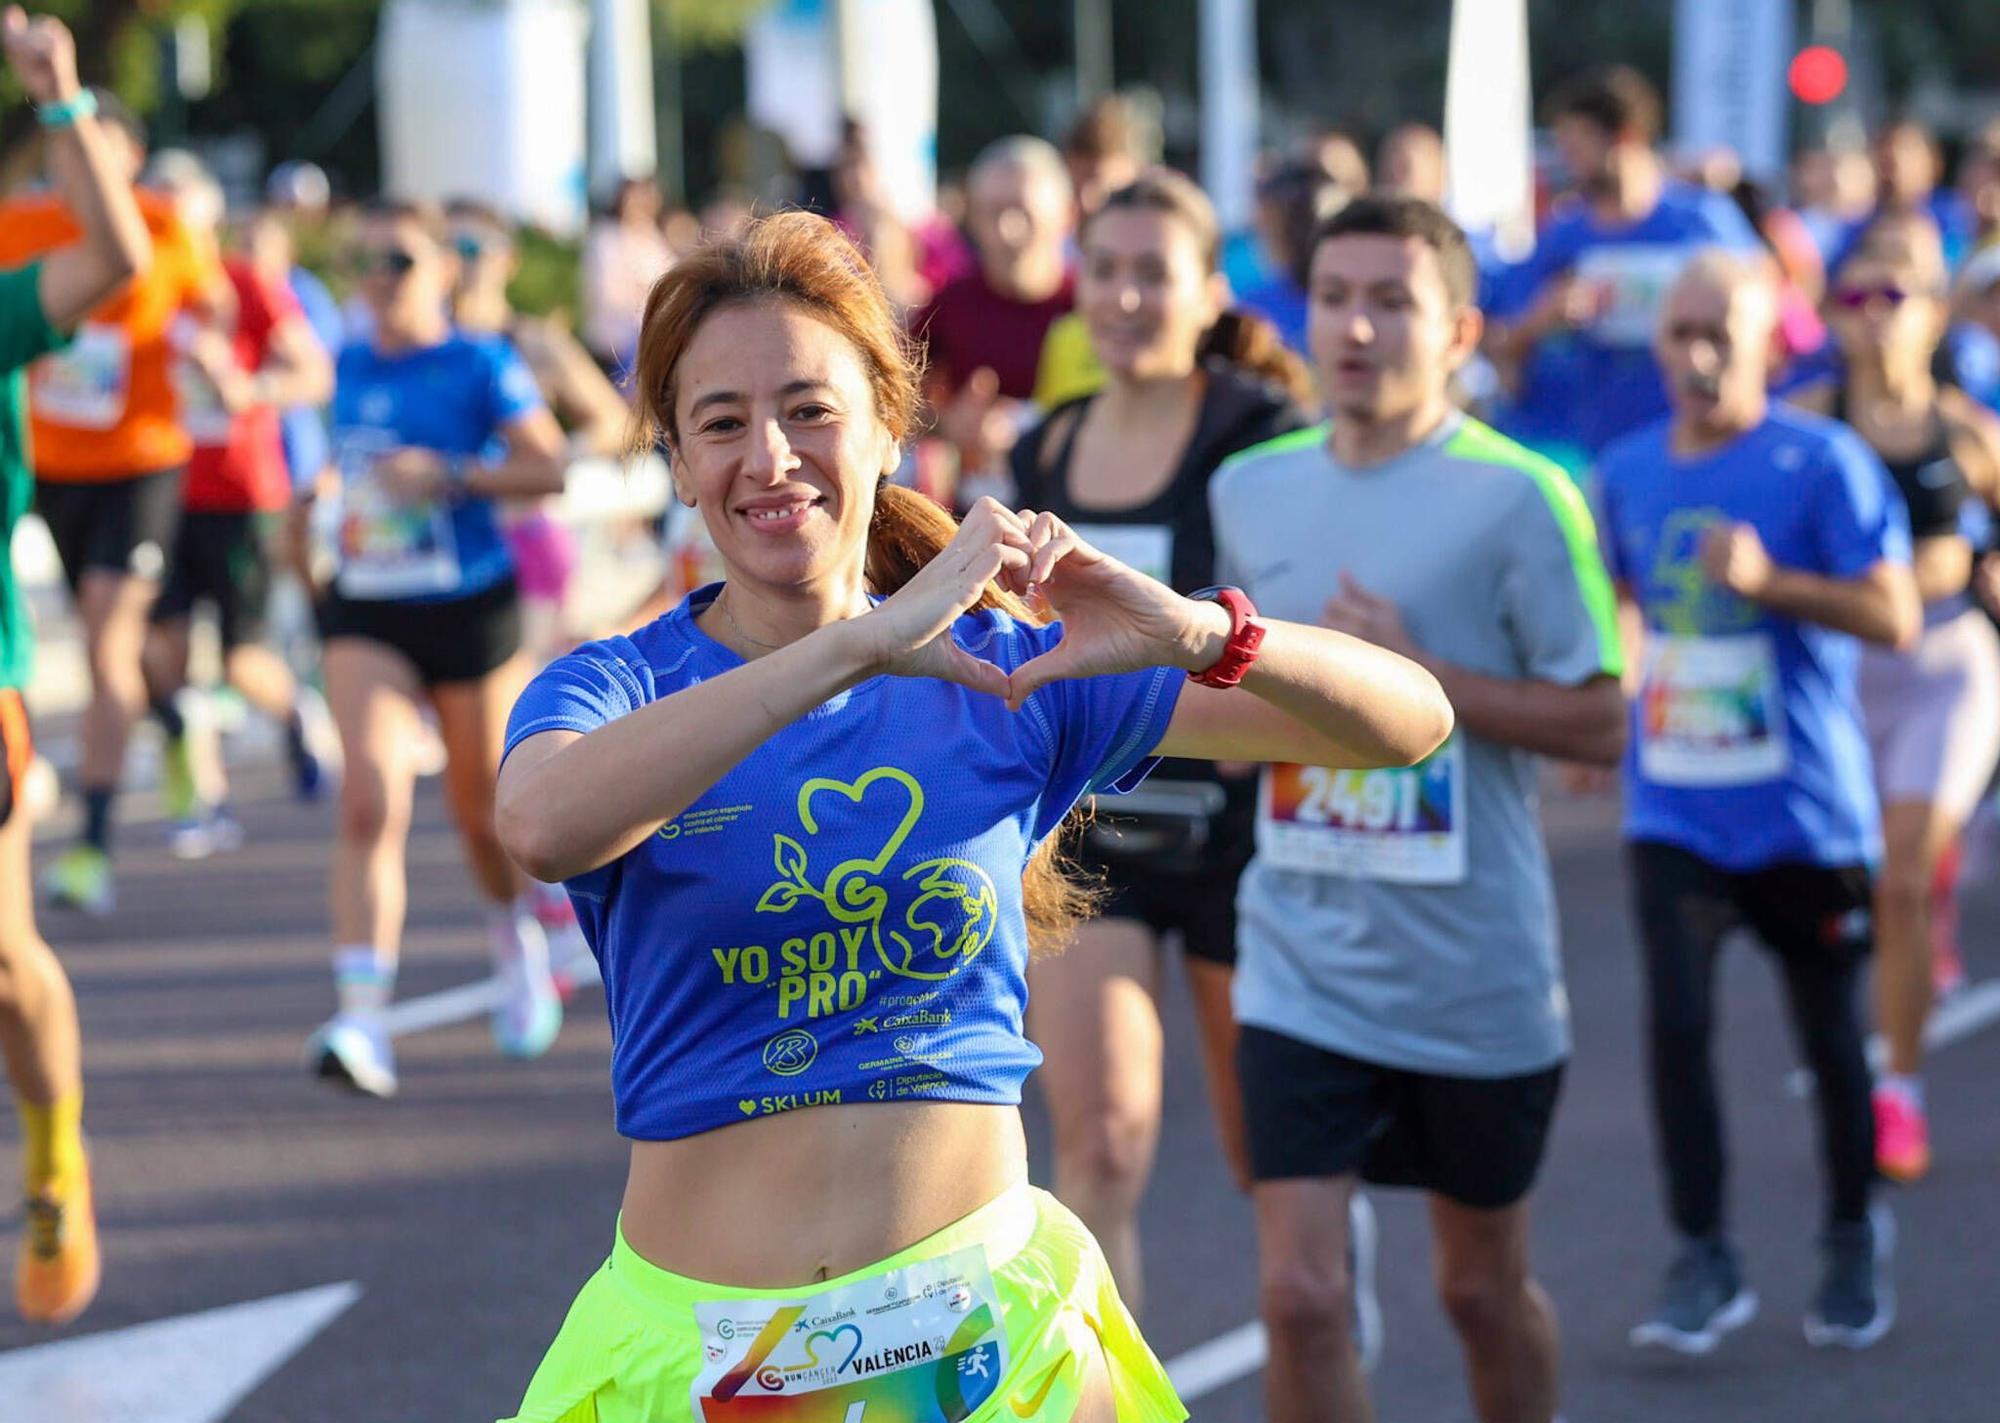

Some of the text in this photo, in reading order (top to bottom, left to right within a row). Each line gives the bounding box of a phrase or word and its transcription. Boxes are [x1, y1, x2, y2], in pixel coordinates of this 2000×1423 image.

[1295, 766, 1418, 830] 2491
[711, 926, 868, 984] YO SOY
[760, 1088, 841, 1114] SKLUM
[852, 1340, 932, 1376] VALÈNCIA
